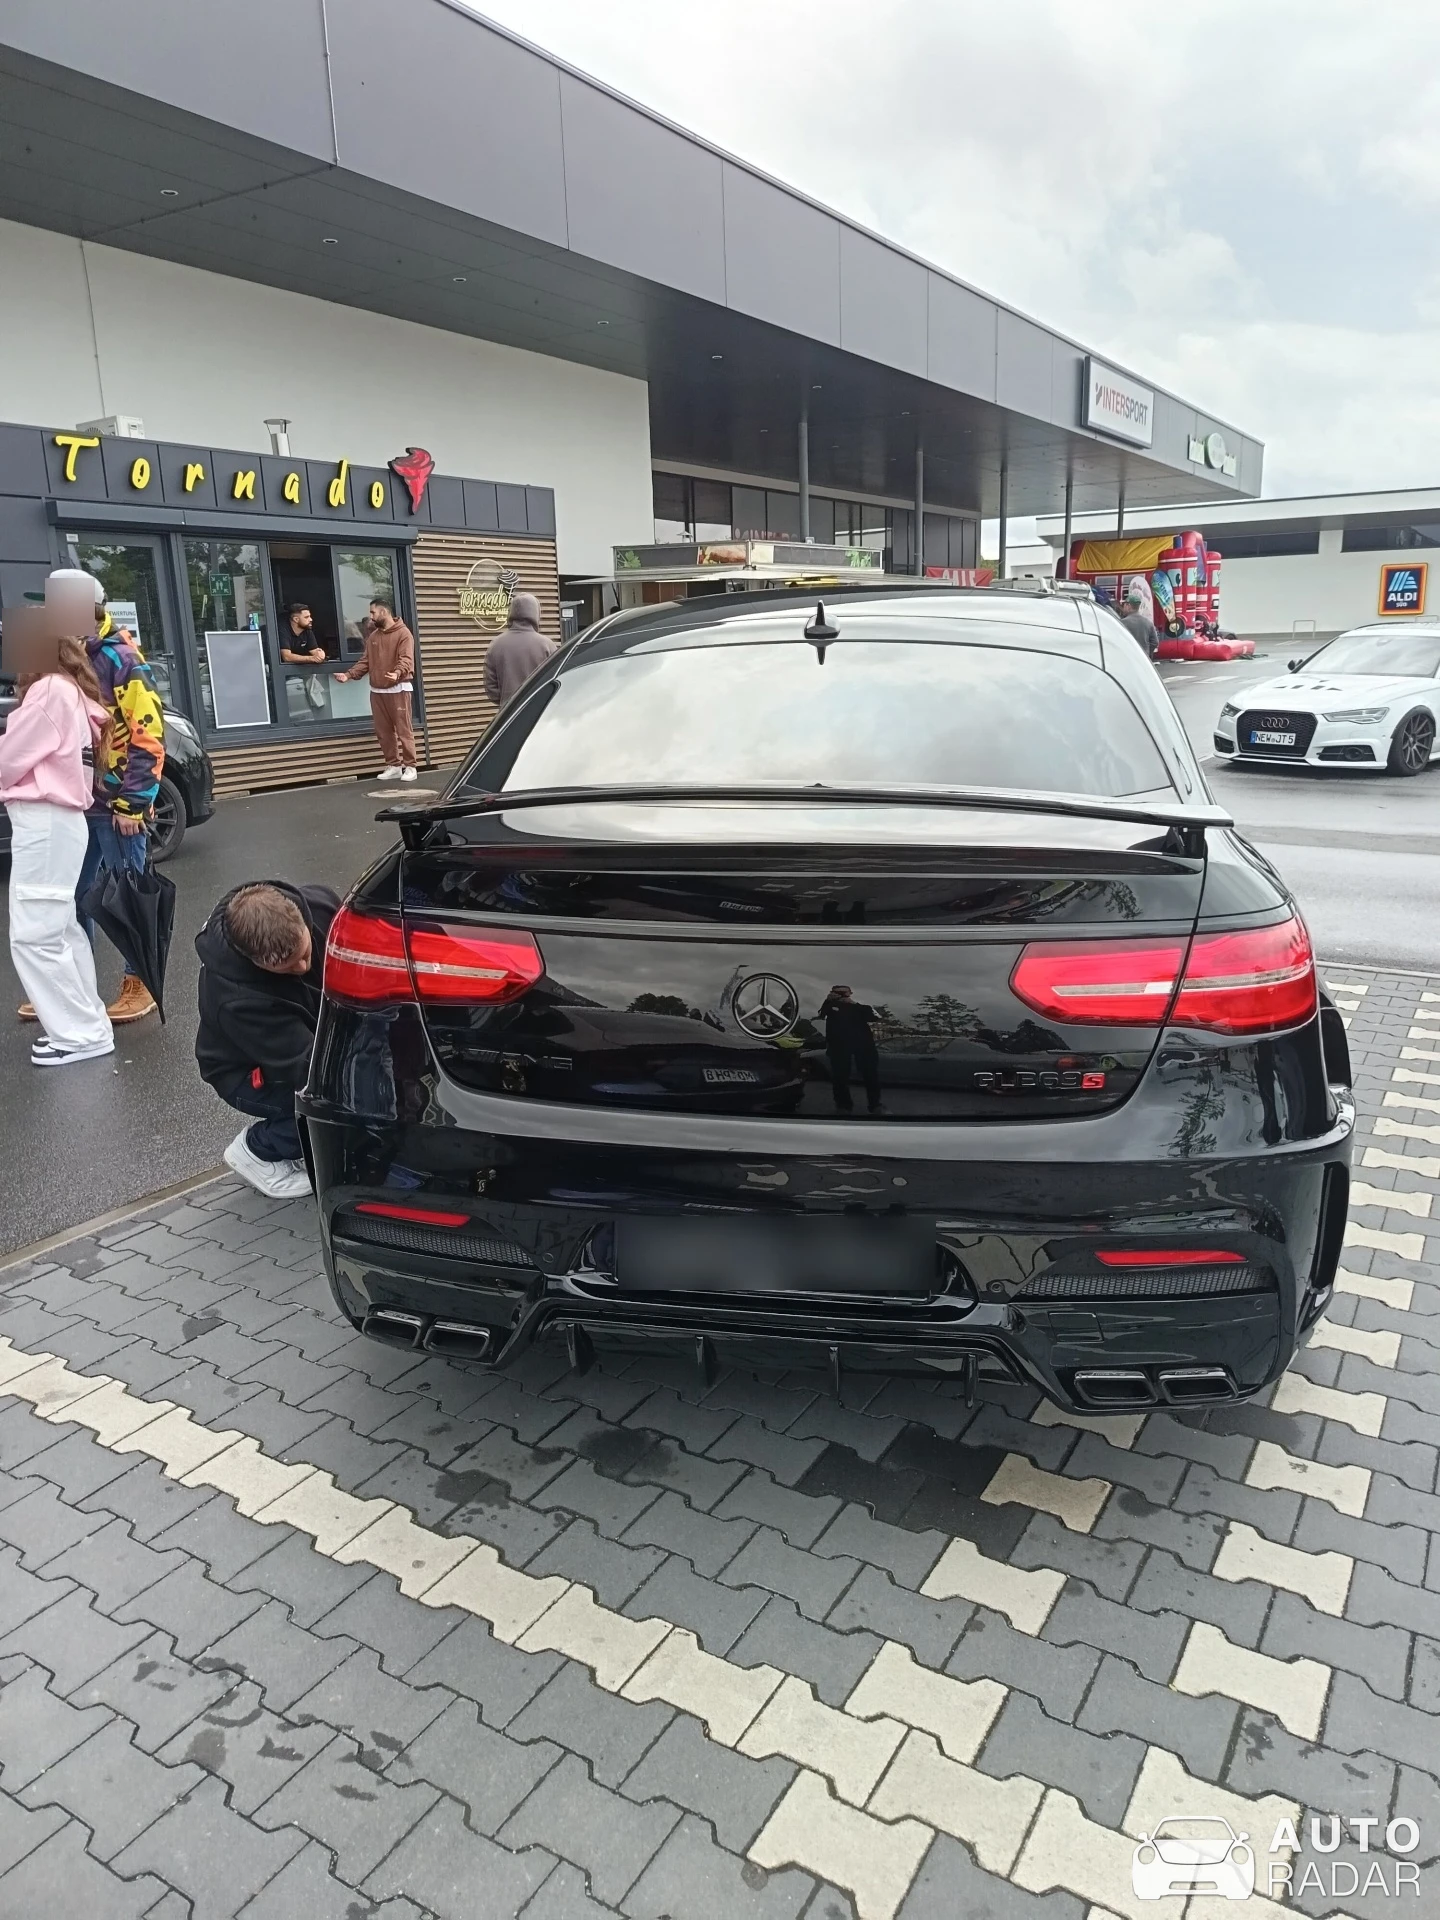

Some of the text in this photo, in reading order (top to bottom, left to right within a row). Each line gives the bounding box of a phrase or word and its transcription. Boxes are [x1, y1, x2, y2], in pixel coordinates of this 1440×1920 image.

[1103, 385, 1149, 427] INTERSPORT
[55, 435, 385, 508] Tornado
[456, 584, 508, 608] Tornado
[1387, 592, 1418, 602] ALDI
[1276, 734, 1287, 744] JT
[1288, 735, 1295, 744] 5
